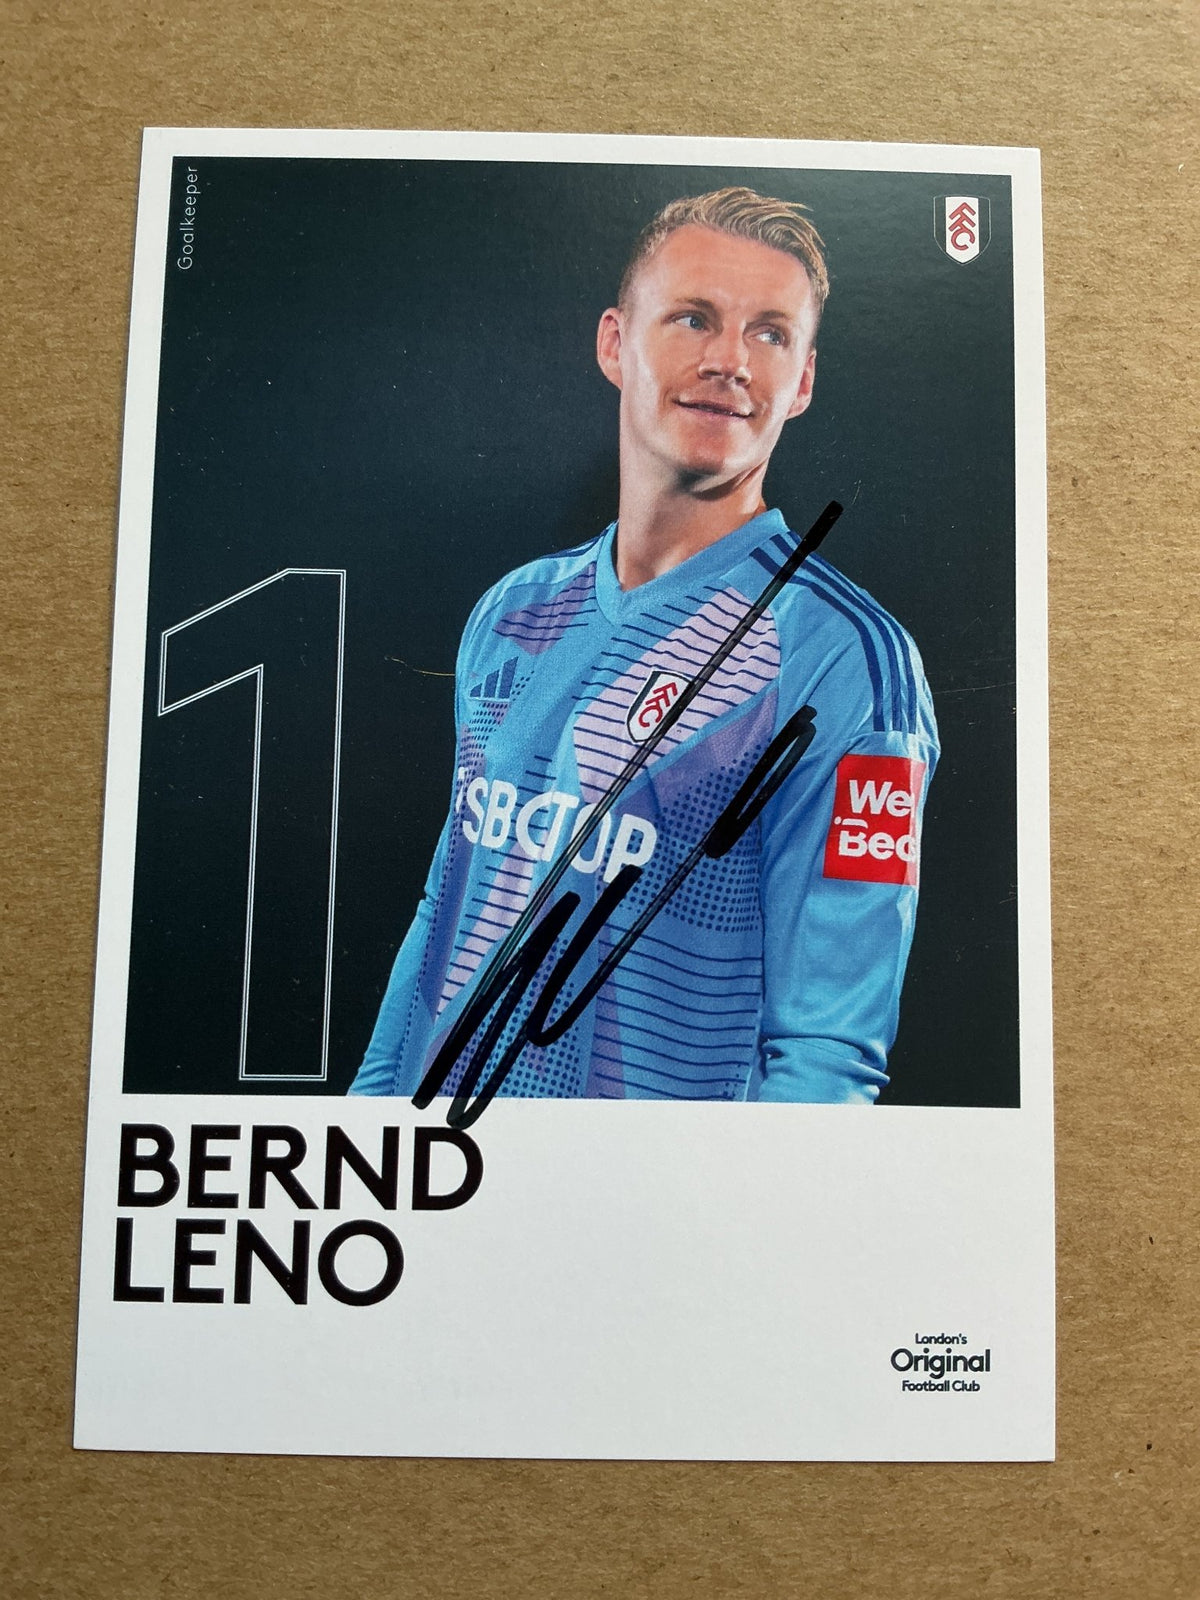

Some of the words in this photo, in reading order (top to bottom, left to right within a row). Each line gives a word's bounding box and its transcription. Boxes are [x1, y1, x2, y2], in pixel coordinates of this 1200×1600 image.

[177, 166, 201, 270] Goalkeeper
[948, 202, 976, 251] FFC
[158, 568, 346, 1081] 1
[117, 1123, 484, 1211] BERND
[113, 1217, 405, 1307] LENO
[890, 1347, 991, 1380] Original
[915, 1332, 968, 1345] London's
[902, 1380, 950, 1392] Football
[952, 1380, 981, 1392] Club
